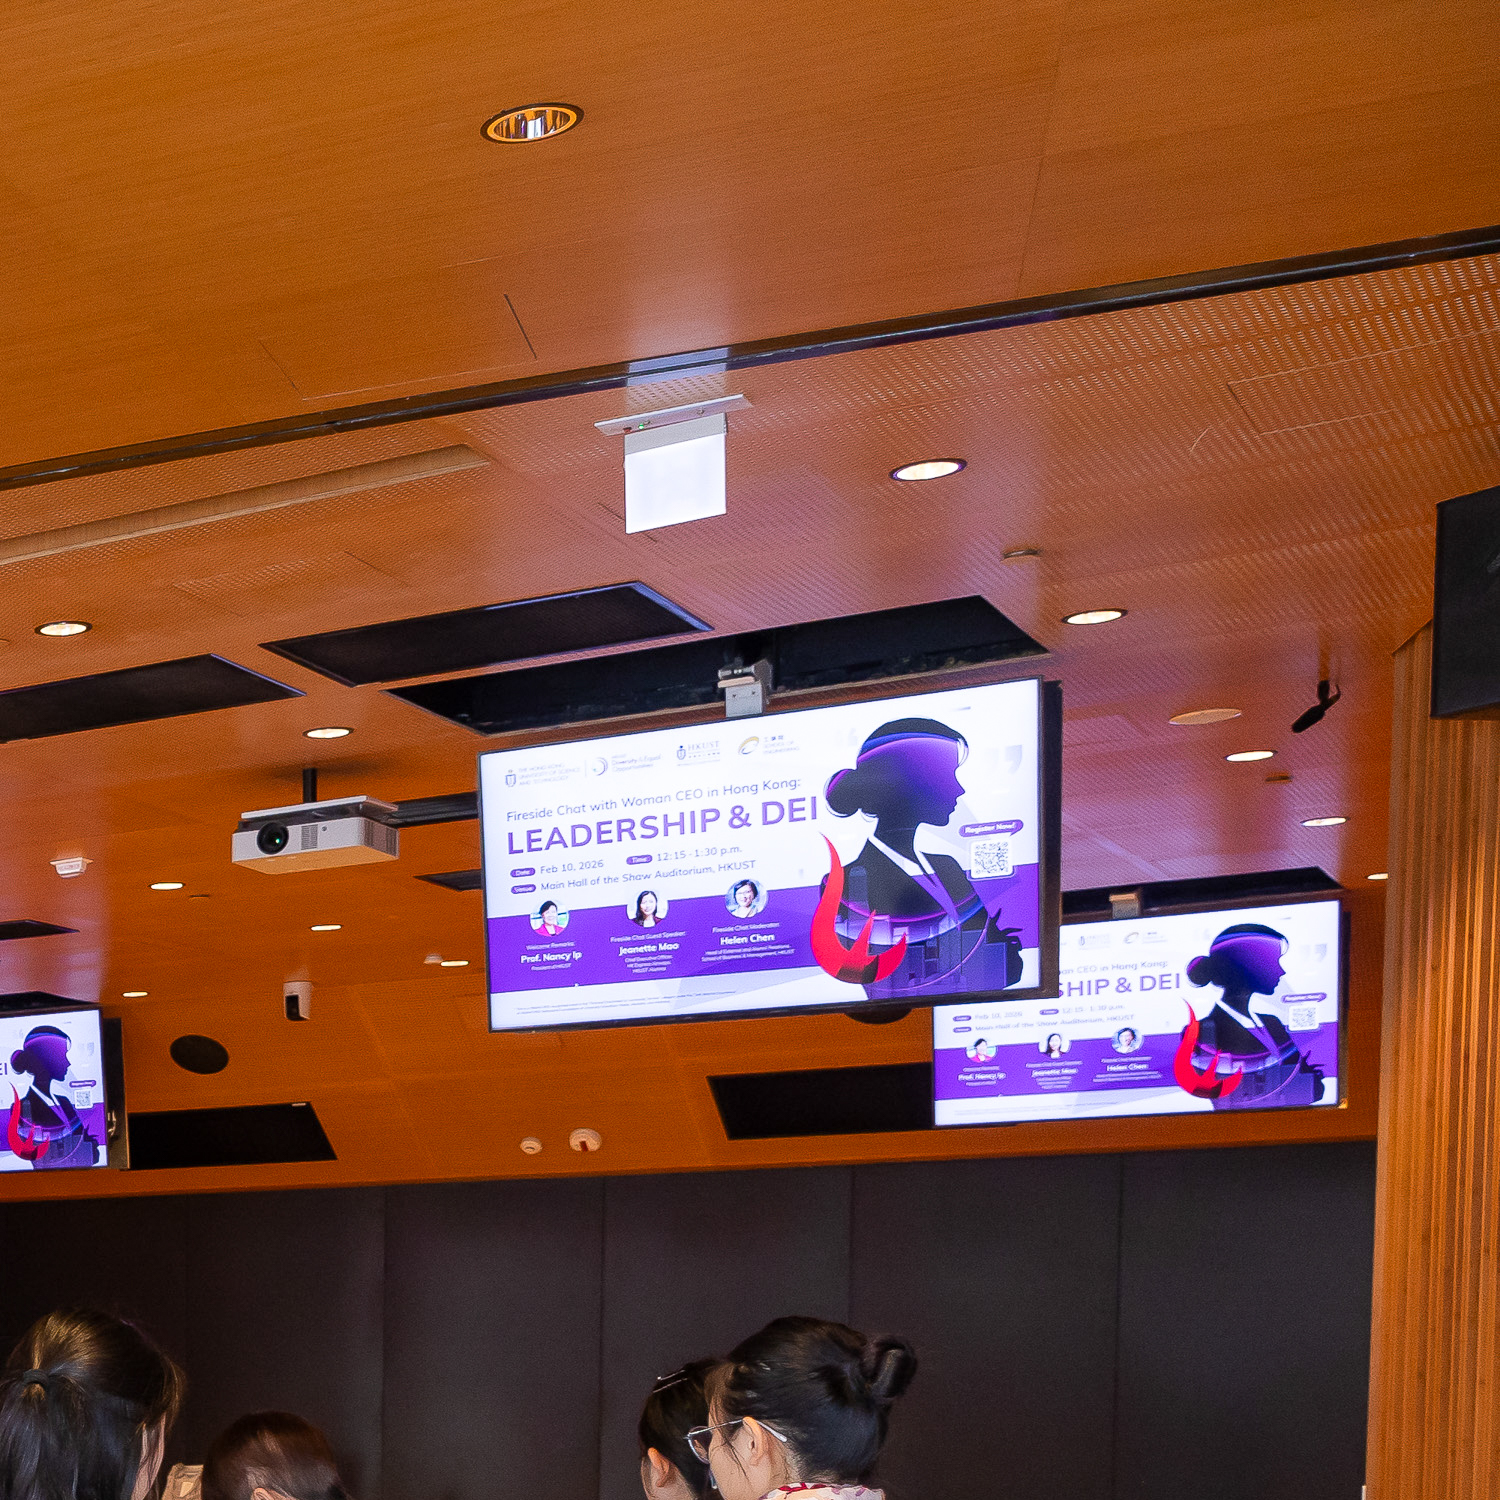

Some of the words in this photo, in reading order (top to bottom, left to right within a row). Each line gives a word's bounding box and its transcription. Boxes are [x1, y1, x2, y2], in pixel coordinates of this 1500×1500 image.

[506, 807, 553, 822] Fireside
[556, 803, 586, 817] Chat
[589, 798, 617, 811] with
[621, 793, 671, 807] Woman
[675, 788, 703, 801] CEO
[707, 785, 719, 797] in
[723, 782, 759, 799] Hong
[763, 777, 801, 794] Kong:
[507, 808, 721, 855] LEADERSHIP
[728, 804, 752, 829] &
[761, 796, 818, 826] DEI
[540, 864, 559, 874] Feb
[562, 863, 577, 875] 10,
[579, 859, 604, 871] 2026
[656, 850, 684, 862] 12:15
[694, 847, 718, 859] 1:30
[720, 847, 743, 858] p.m.
[540, 880, 565, 891] Main
[567, 878, 588, 889] Hall
[590, 875, 602, 886] of
[603, 874, 620, 885] the
[622, 871, 652, 884] Shaw
[654, 865, 716, 880] Auditorium,
[718, 859, 756, 873] HKUST
[618, 945, 657, 957] Jeanette
[658, 942, 680, 952] Mao
[720, 935, 748, 945] Helen
[749, 933, 776, 943] Chen
[520, 954, 542, 964] Prof.
[543, 951, 572, 963] Nancy
[572, 950, 583, 962] Ip
[1115, 977, 1133, 994] &
[1139, 973, 1181, 992] DEI
